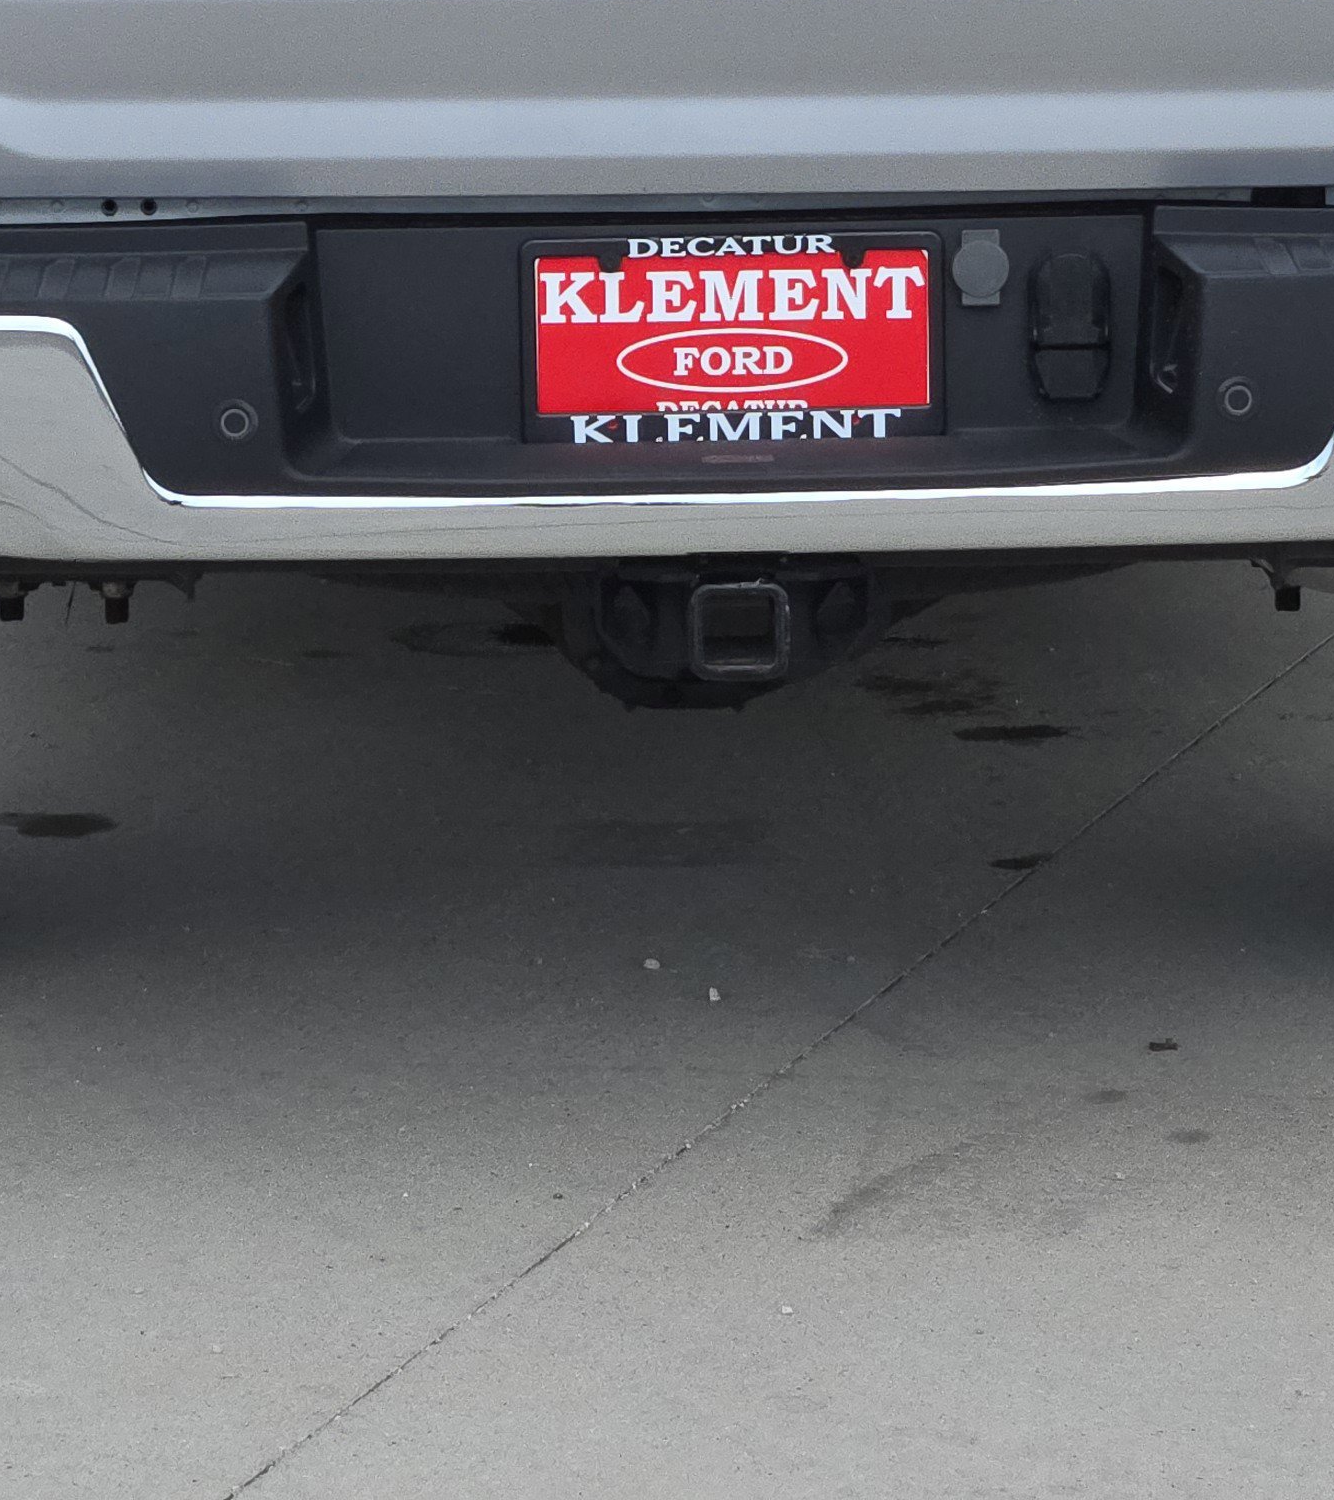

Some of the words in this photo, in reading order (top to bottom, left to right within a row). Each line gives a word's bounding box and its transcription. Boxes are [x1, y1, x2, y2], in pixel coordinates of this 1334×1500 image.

[627, 234, 836, 258] DECATUR
[539, 265, 926, 324] KLEMENT
[672, 345, 794, 376] FORD
[570, 408, 902, 445] KLEMENT
